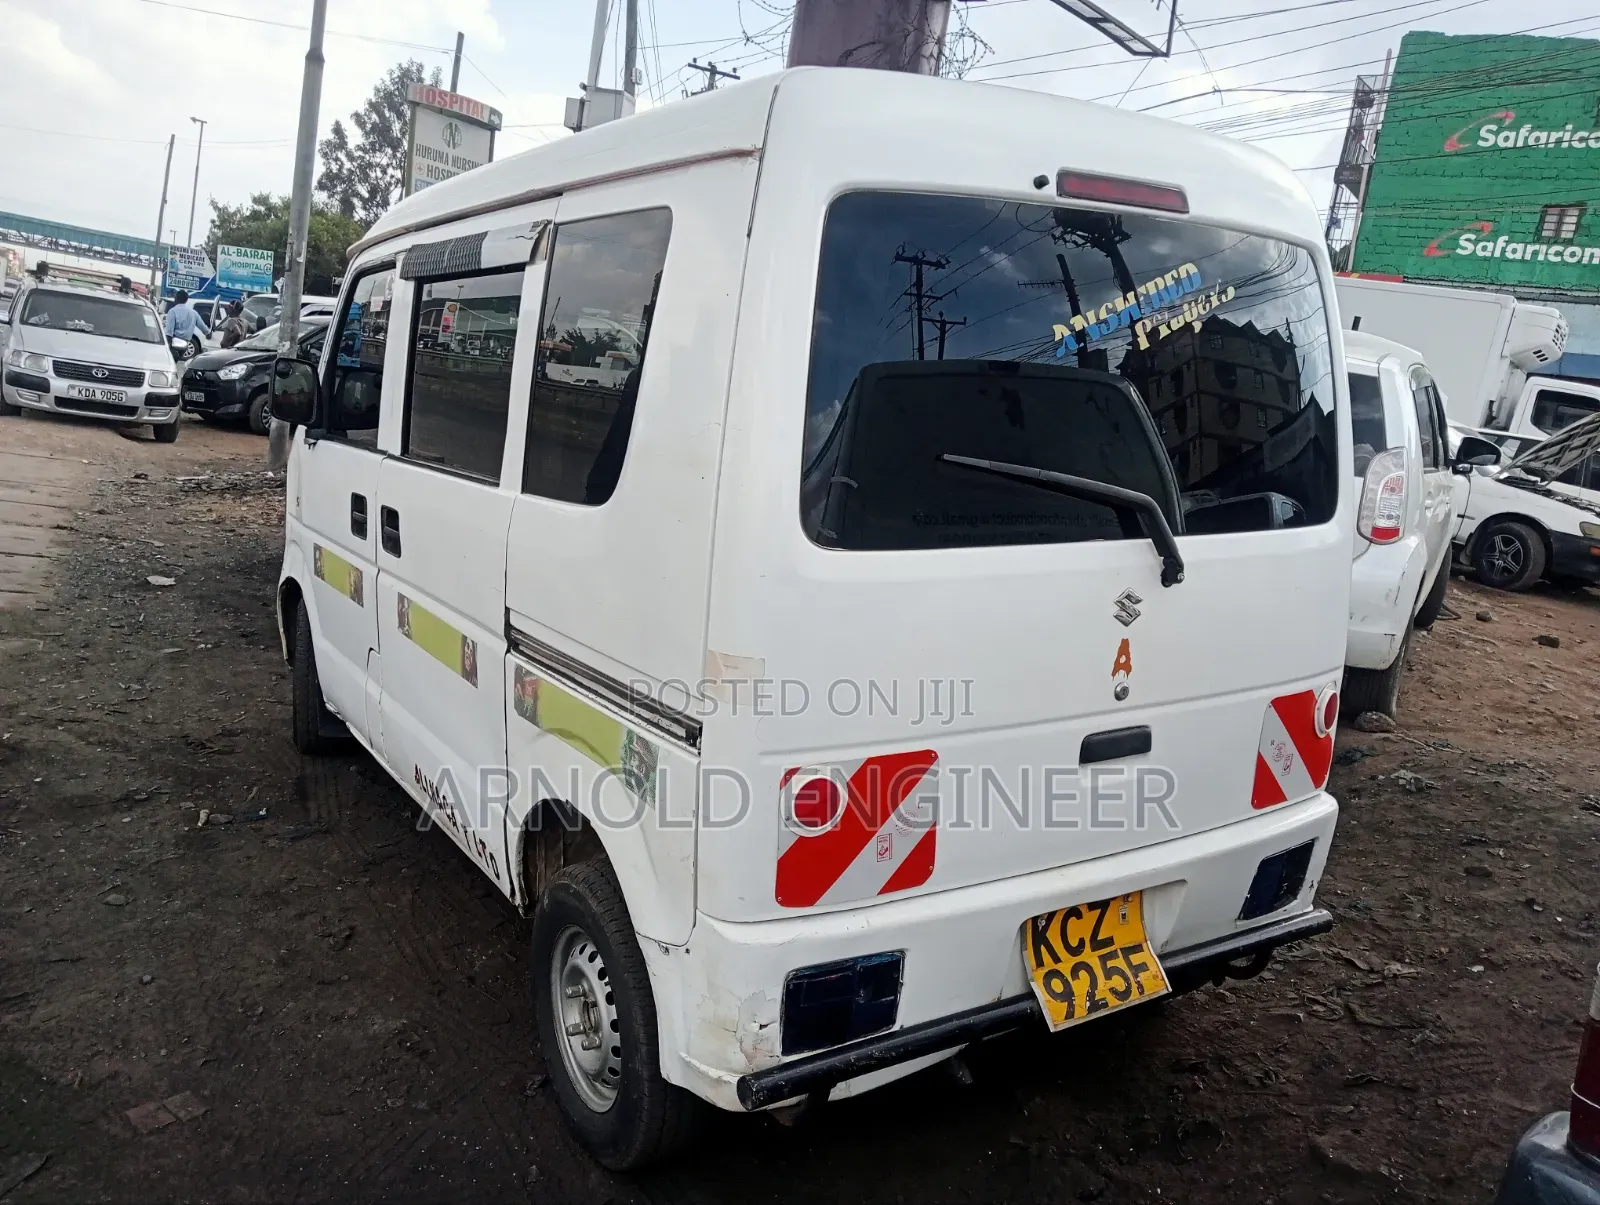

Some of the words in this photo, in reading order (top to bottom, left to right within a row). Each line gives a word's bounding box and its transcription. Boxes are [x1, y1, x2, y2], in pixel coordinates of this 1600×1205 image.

[413, 87, 485, 120] HOSPITAL
[415, 143, 449, 166] HURUMA
[451, 154, 483, 171] NURSI
[427, 164, 460, 180] HOSP
[220, 246, 273, 261] AL-BASRAH
[179, 259, 204, 267] CENTRE
[232, 260, 262, 270] HOSPITAL
[78, 388, 96, 399] KDA
[100, 390, 124, 402] 905G
[1031, 898, 1116, 969] KCZ
[1042, 943, 1151, 1021] 925F
